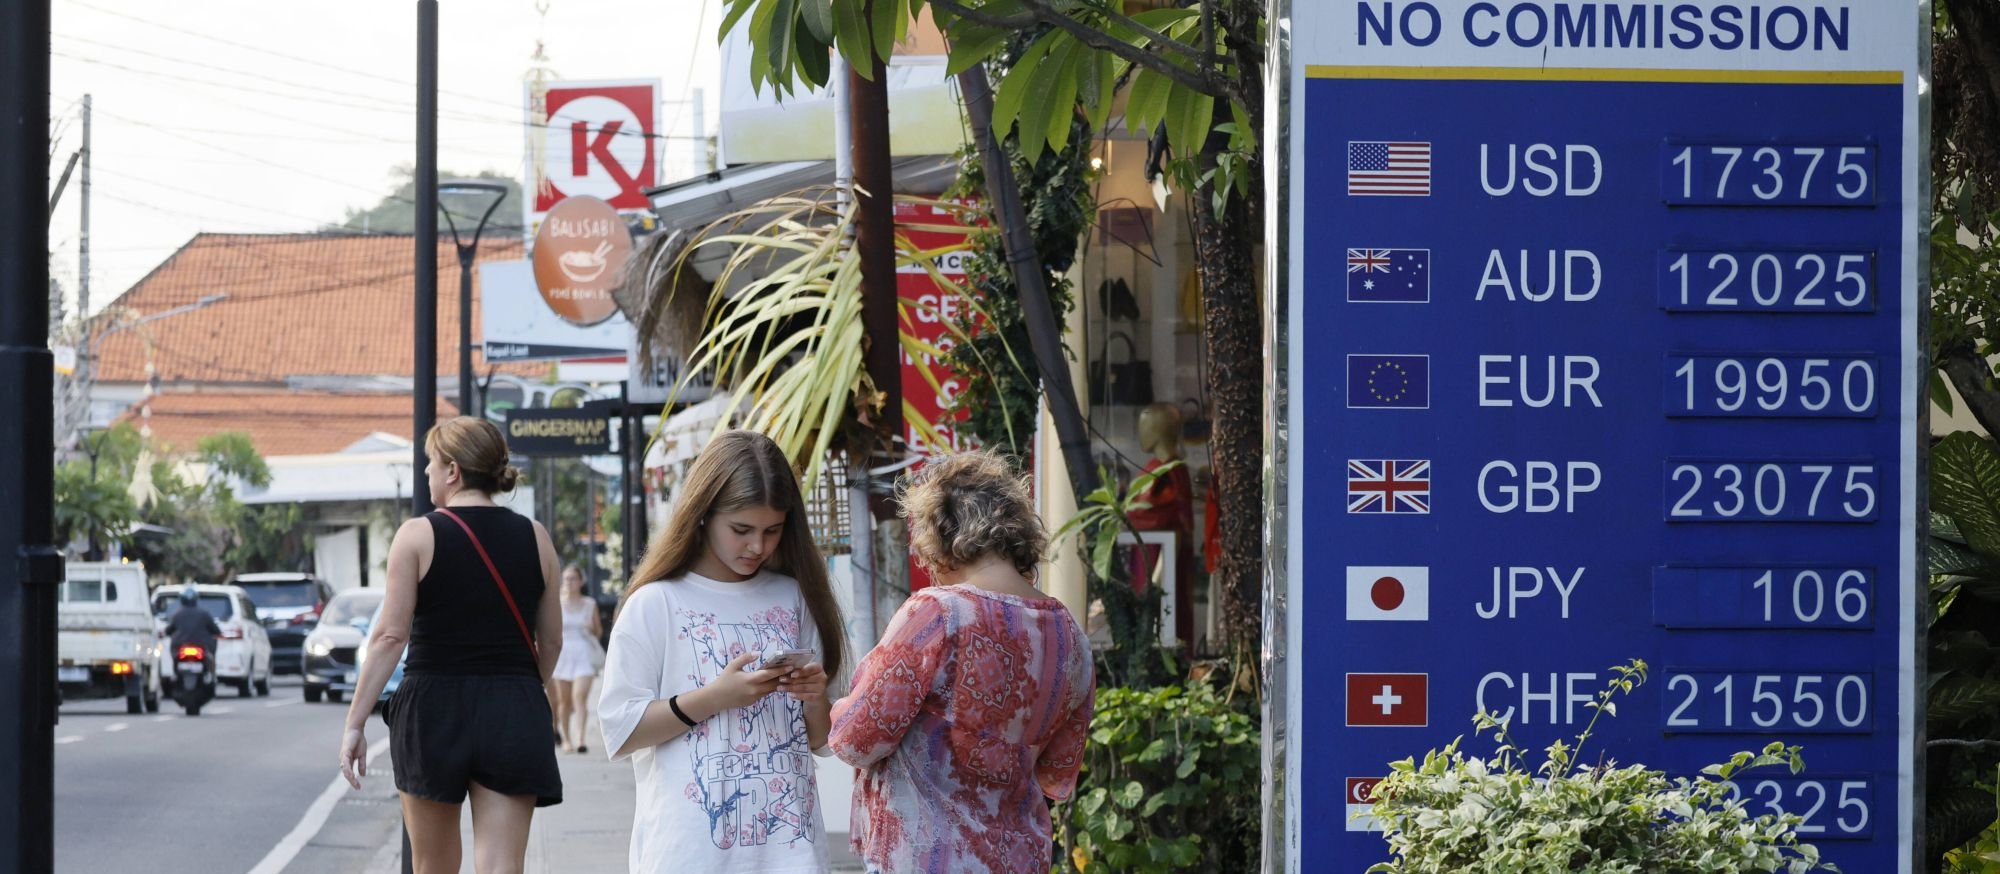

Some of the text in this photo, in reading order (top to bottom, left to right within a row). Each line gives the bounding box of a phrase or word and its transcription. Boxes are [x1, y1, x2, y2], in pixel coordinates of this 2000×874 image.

[1357, 1, 1850, 52] NO COMMISSION
[1480, 143, 1868, 200] USD 17375
[550, 216, 615, 238] BALISABI
[1475, 249, 1866, 306] AUD 12025
[1479, 354, 1874, 412] EUR 19950
[1477, 460, 1875, 517] GBP 23075
[1475, 566, 1867, 622] JPY 106
[1475, 671, 1867, 727] CHF 21550
